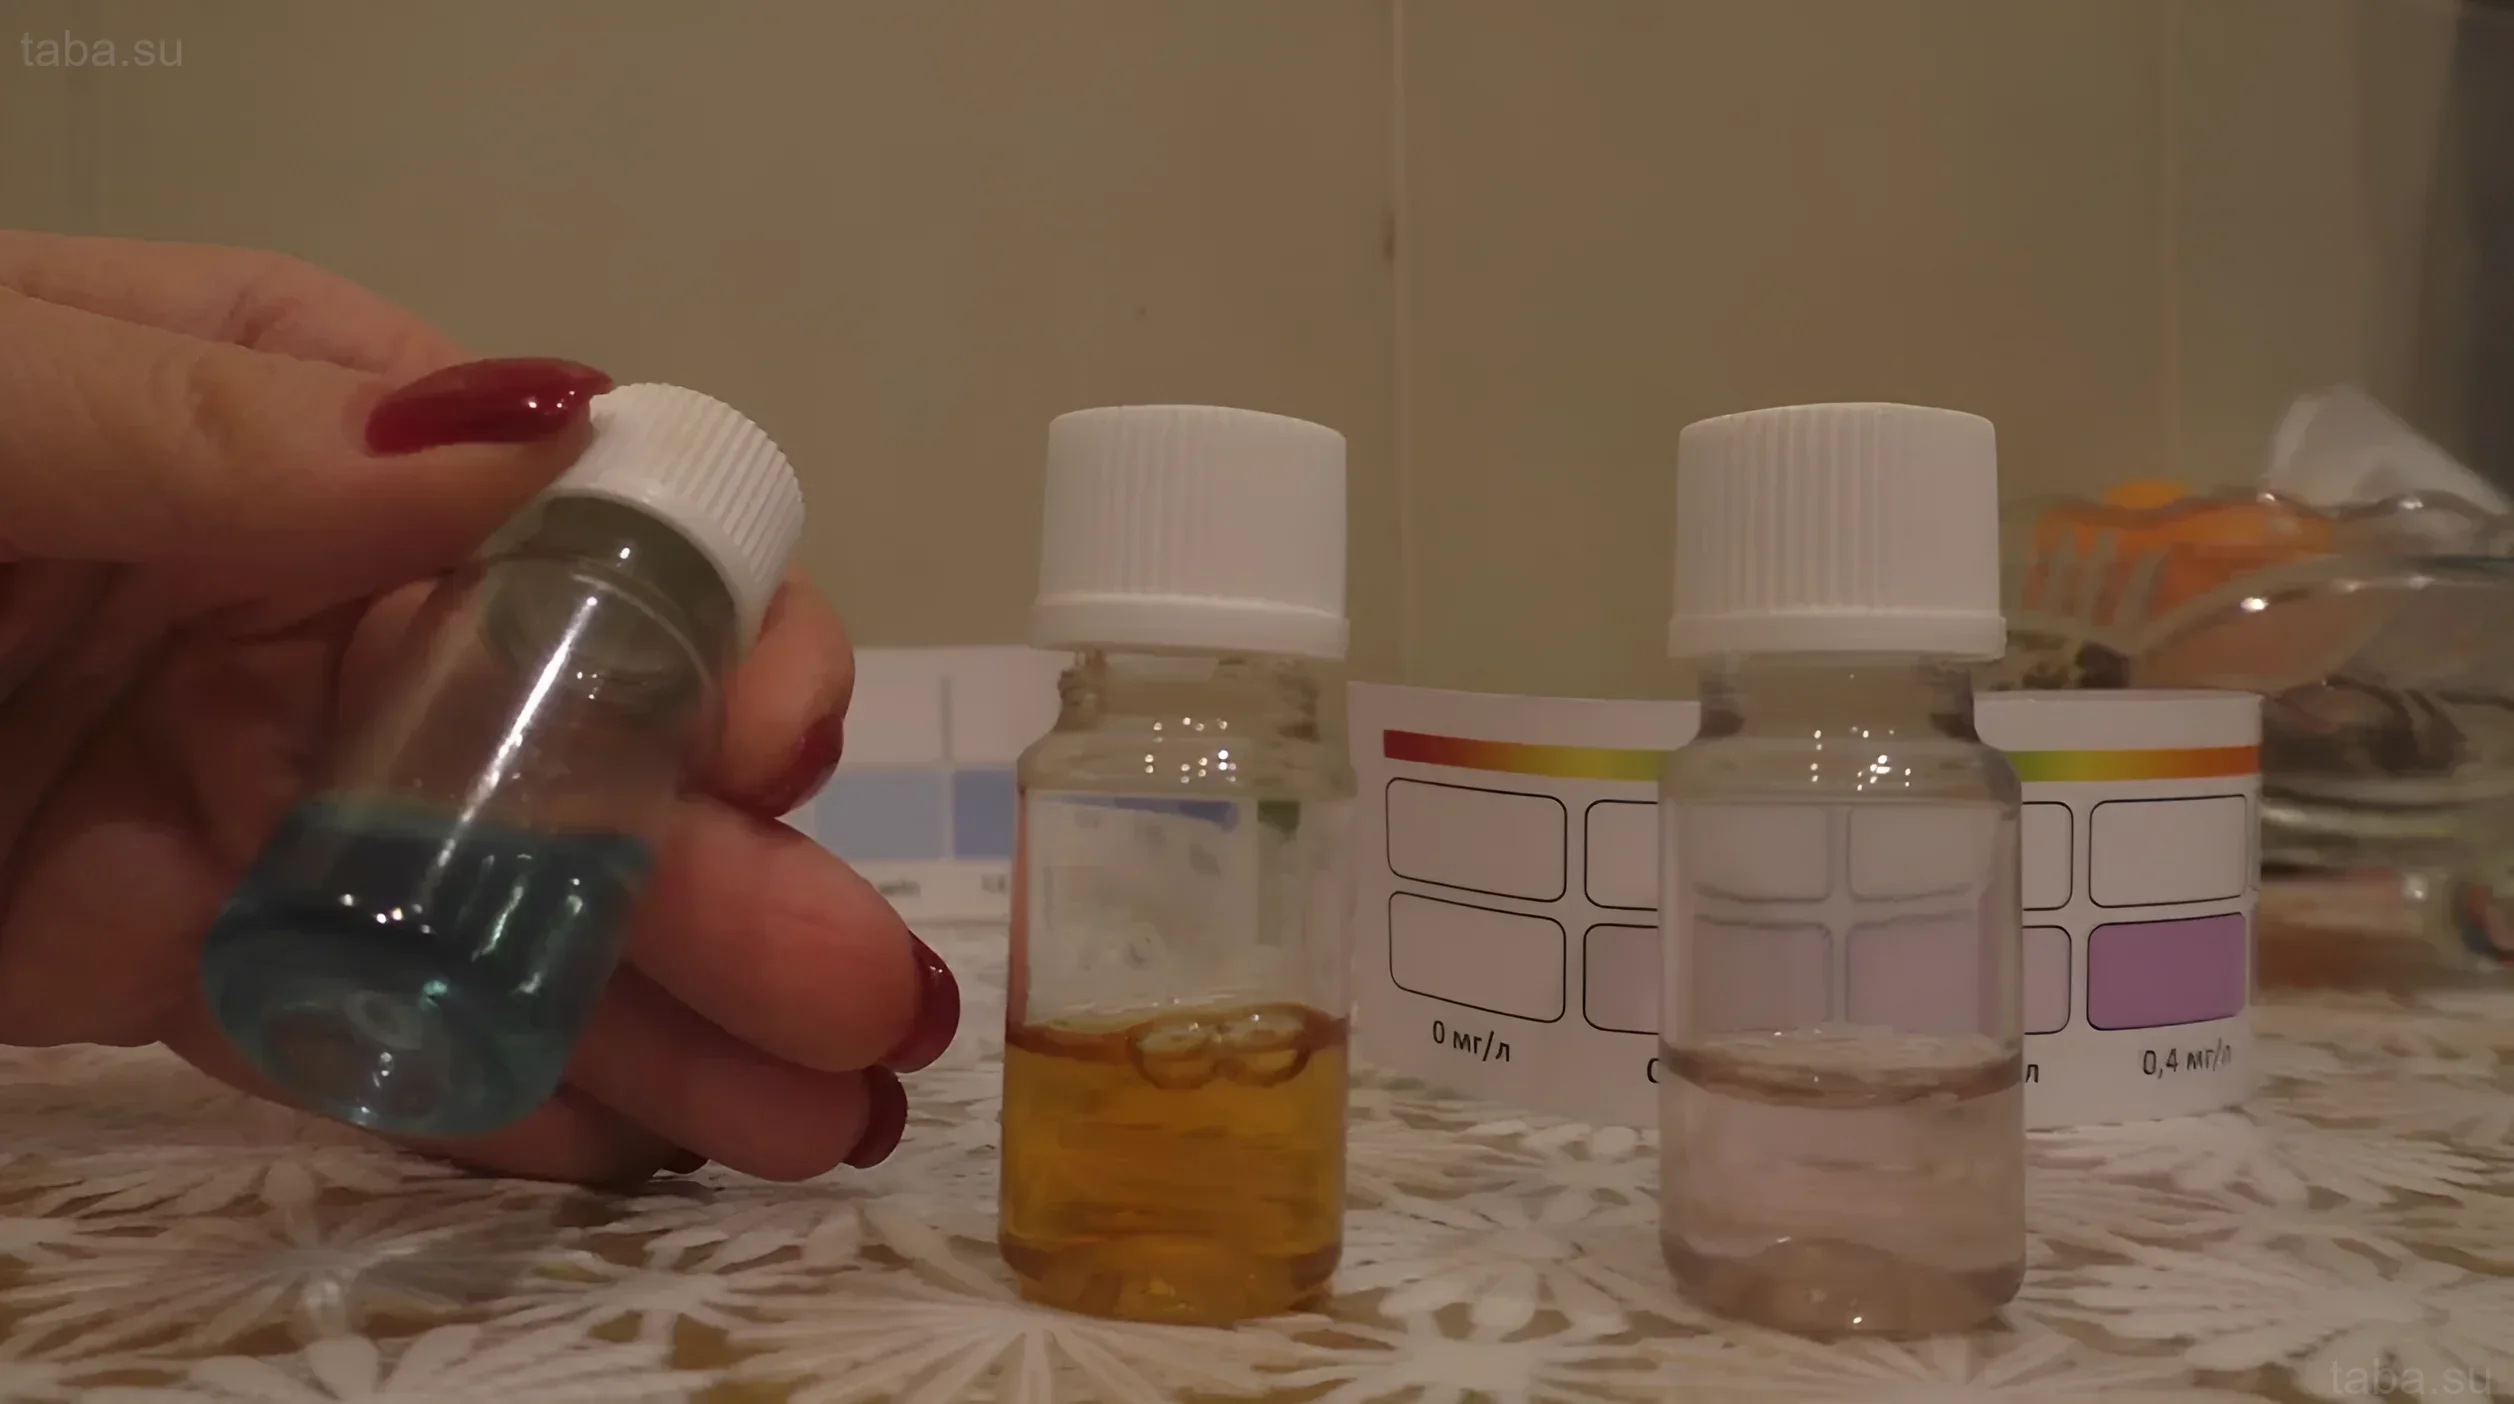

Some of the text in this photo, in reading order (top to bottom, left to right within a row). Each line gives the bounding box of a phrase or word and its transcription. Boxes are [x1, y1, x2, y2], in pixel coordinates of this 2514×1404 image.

[1433, 1020, 1510, 1062] 0 мг/л
[2143, 1048, 2179, 1079] 0,4
